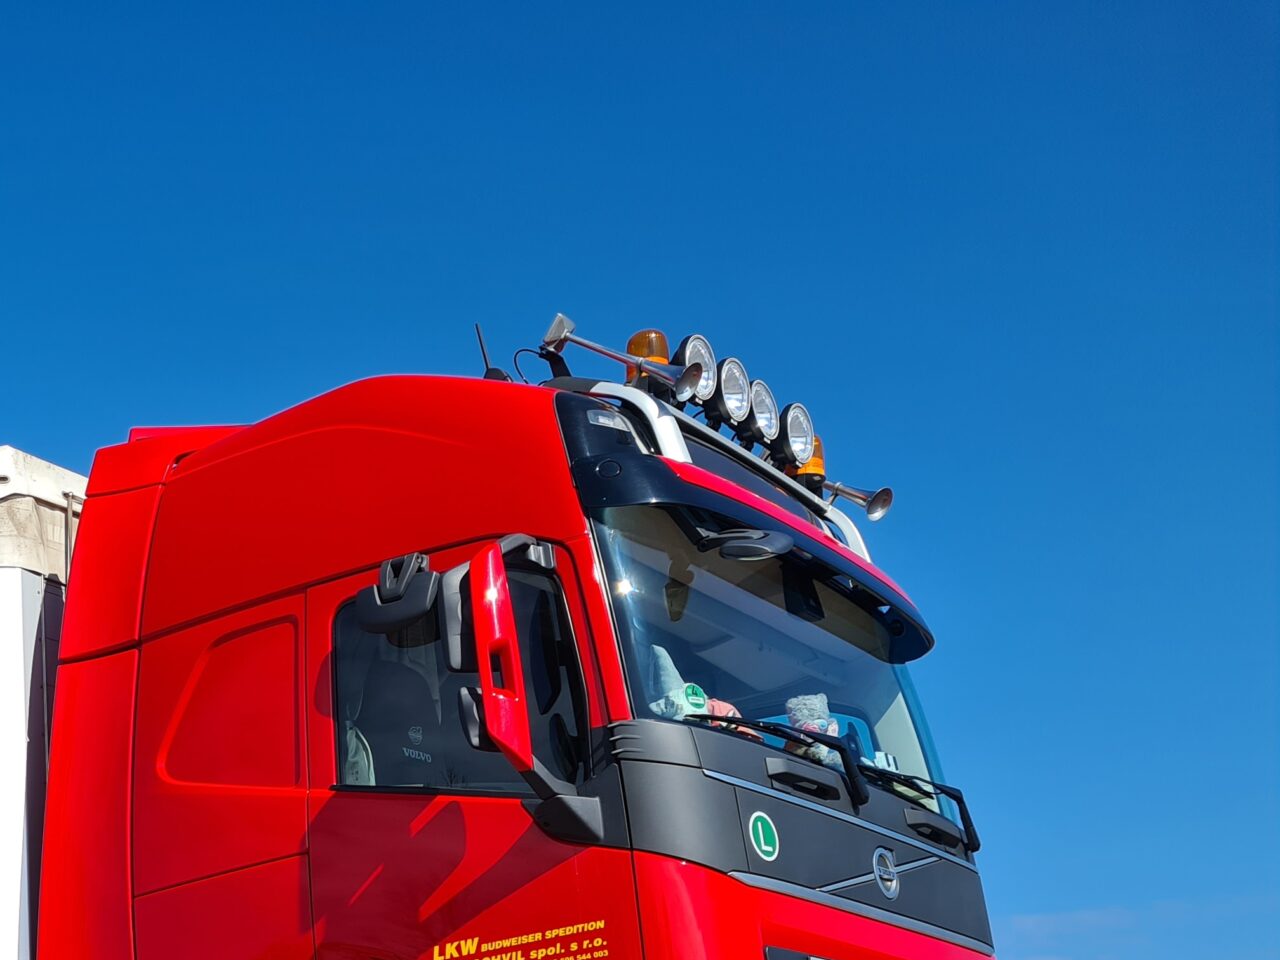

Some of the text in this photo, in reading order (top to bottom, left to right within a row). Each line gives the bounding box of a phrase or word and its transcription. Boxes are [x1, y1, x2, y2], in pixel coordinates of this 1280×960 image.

[401, 746, 432, 763] VOLVO
[757, 821, 774, 852] L
[480, 932, 543, 953] BUDWEISER
[544, 919, 605, 940] SPEDITION
[569, 941, 578, 952] s
[582, 936, 608, 949] r.o.
